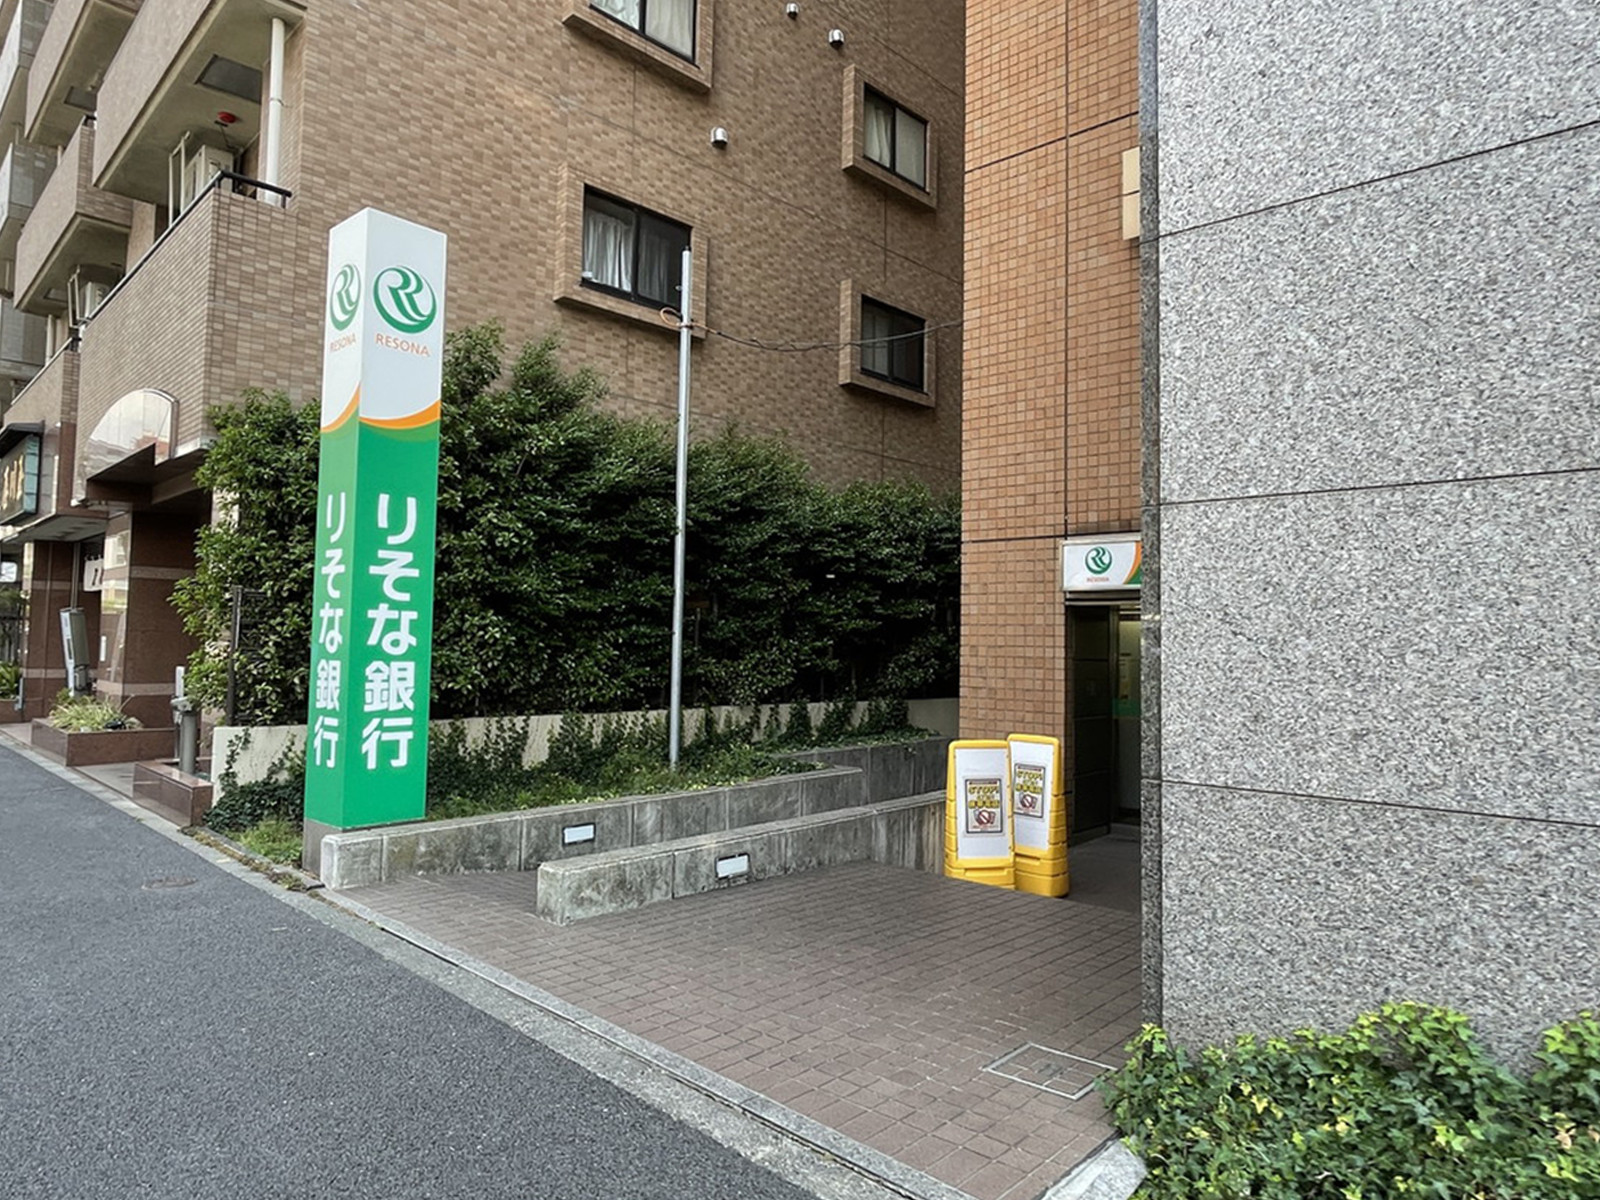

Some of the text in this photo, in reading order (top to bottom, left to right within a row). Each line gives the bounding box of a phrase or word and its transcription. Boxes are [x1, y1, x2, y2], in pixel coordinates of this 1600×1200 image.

[330, 333, 357, 354] RESONA
[375, 333, 431, 357] RESONA
[314, 491, 346, 769] りそな銀行
[361, 493, 420, 770] りそな銀行
